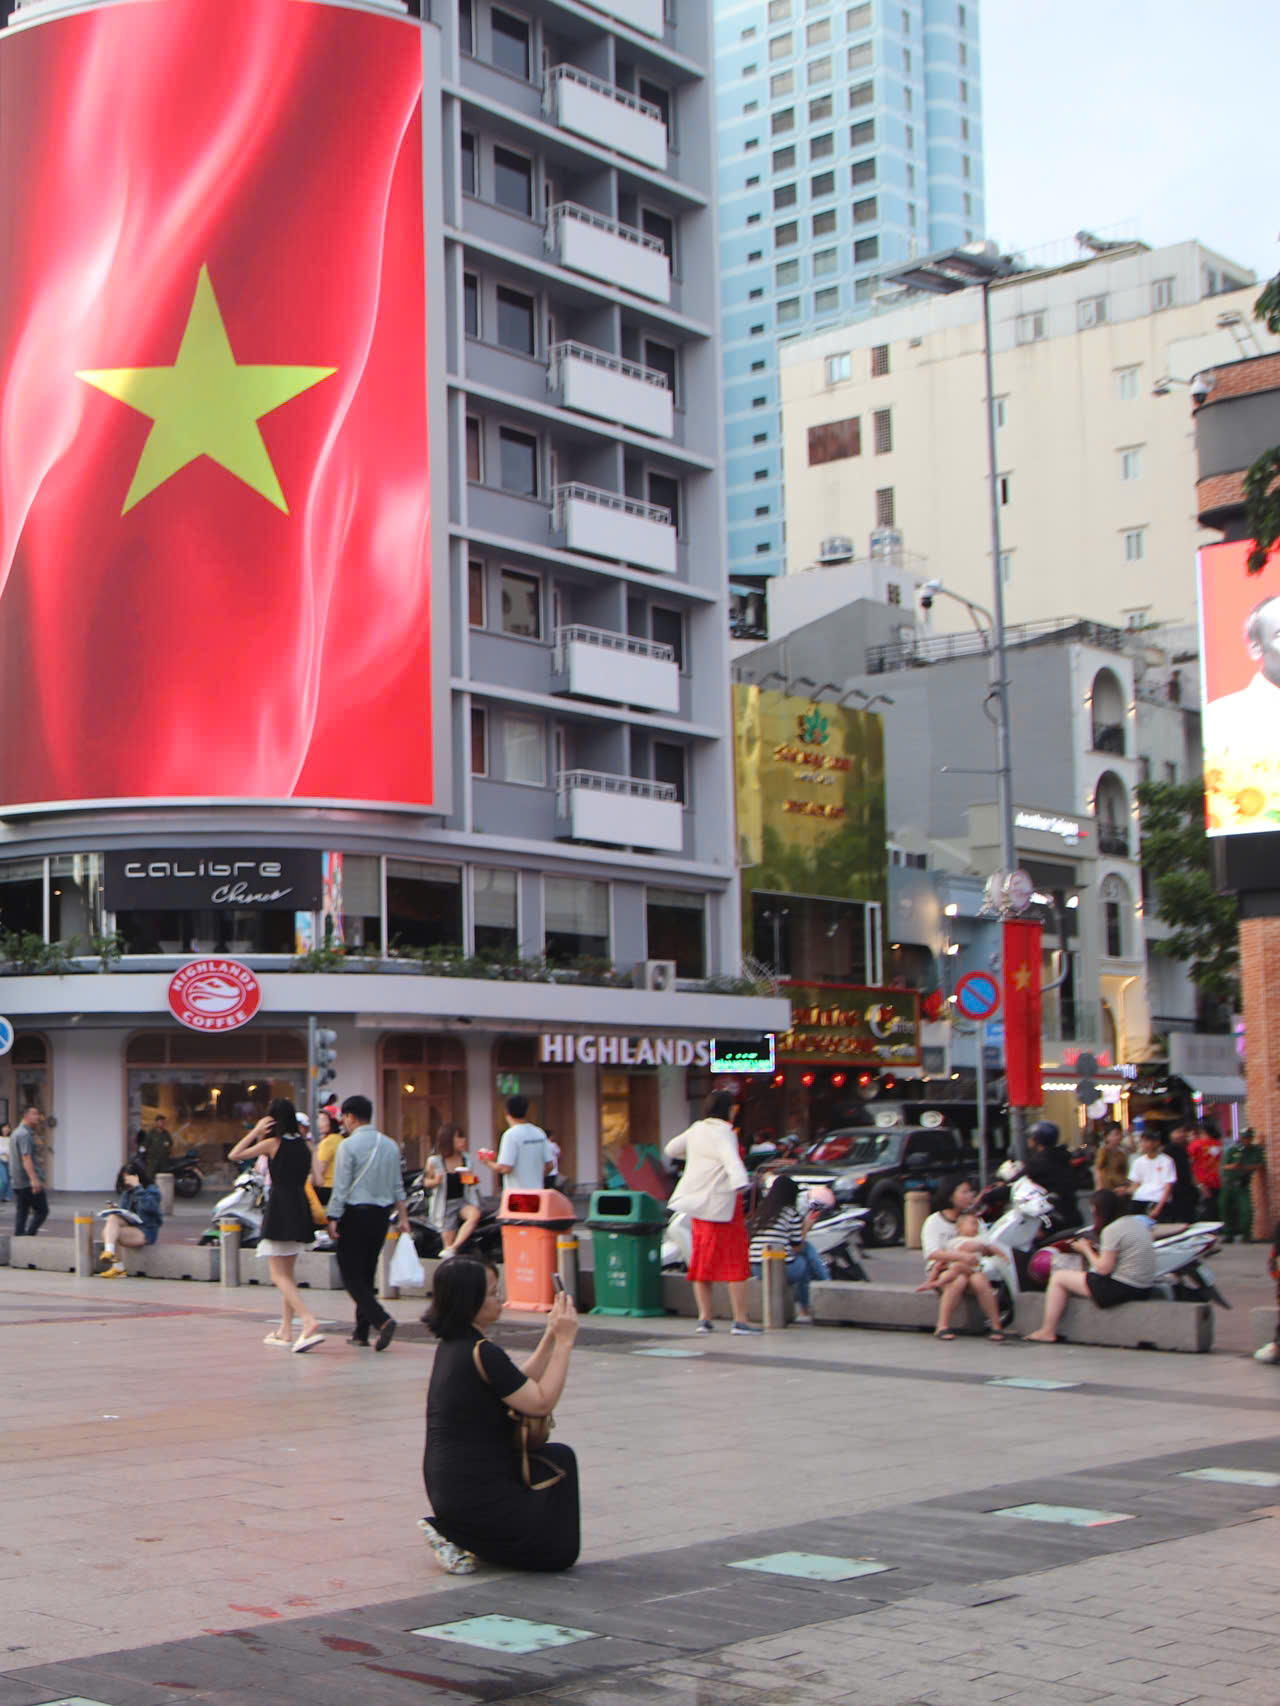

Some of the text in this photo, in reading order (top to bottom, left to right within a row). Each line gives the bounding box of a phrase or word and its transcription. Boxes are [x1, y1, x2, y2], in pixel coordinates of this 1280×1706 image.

[172, 961, 257, 992] HIGHLANDS
[182, 1010, 248, 1029] COFFEE
[541, 1033, 710, 1067] HIGHLANDS
